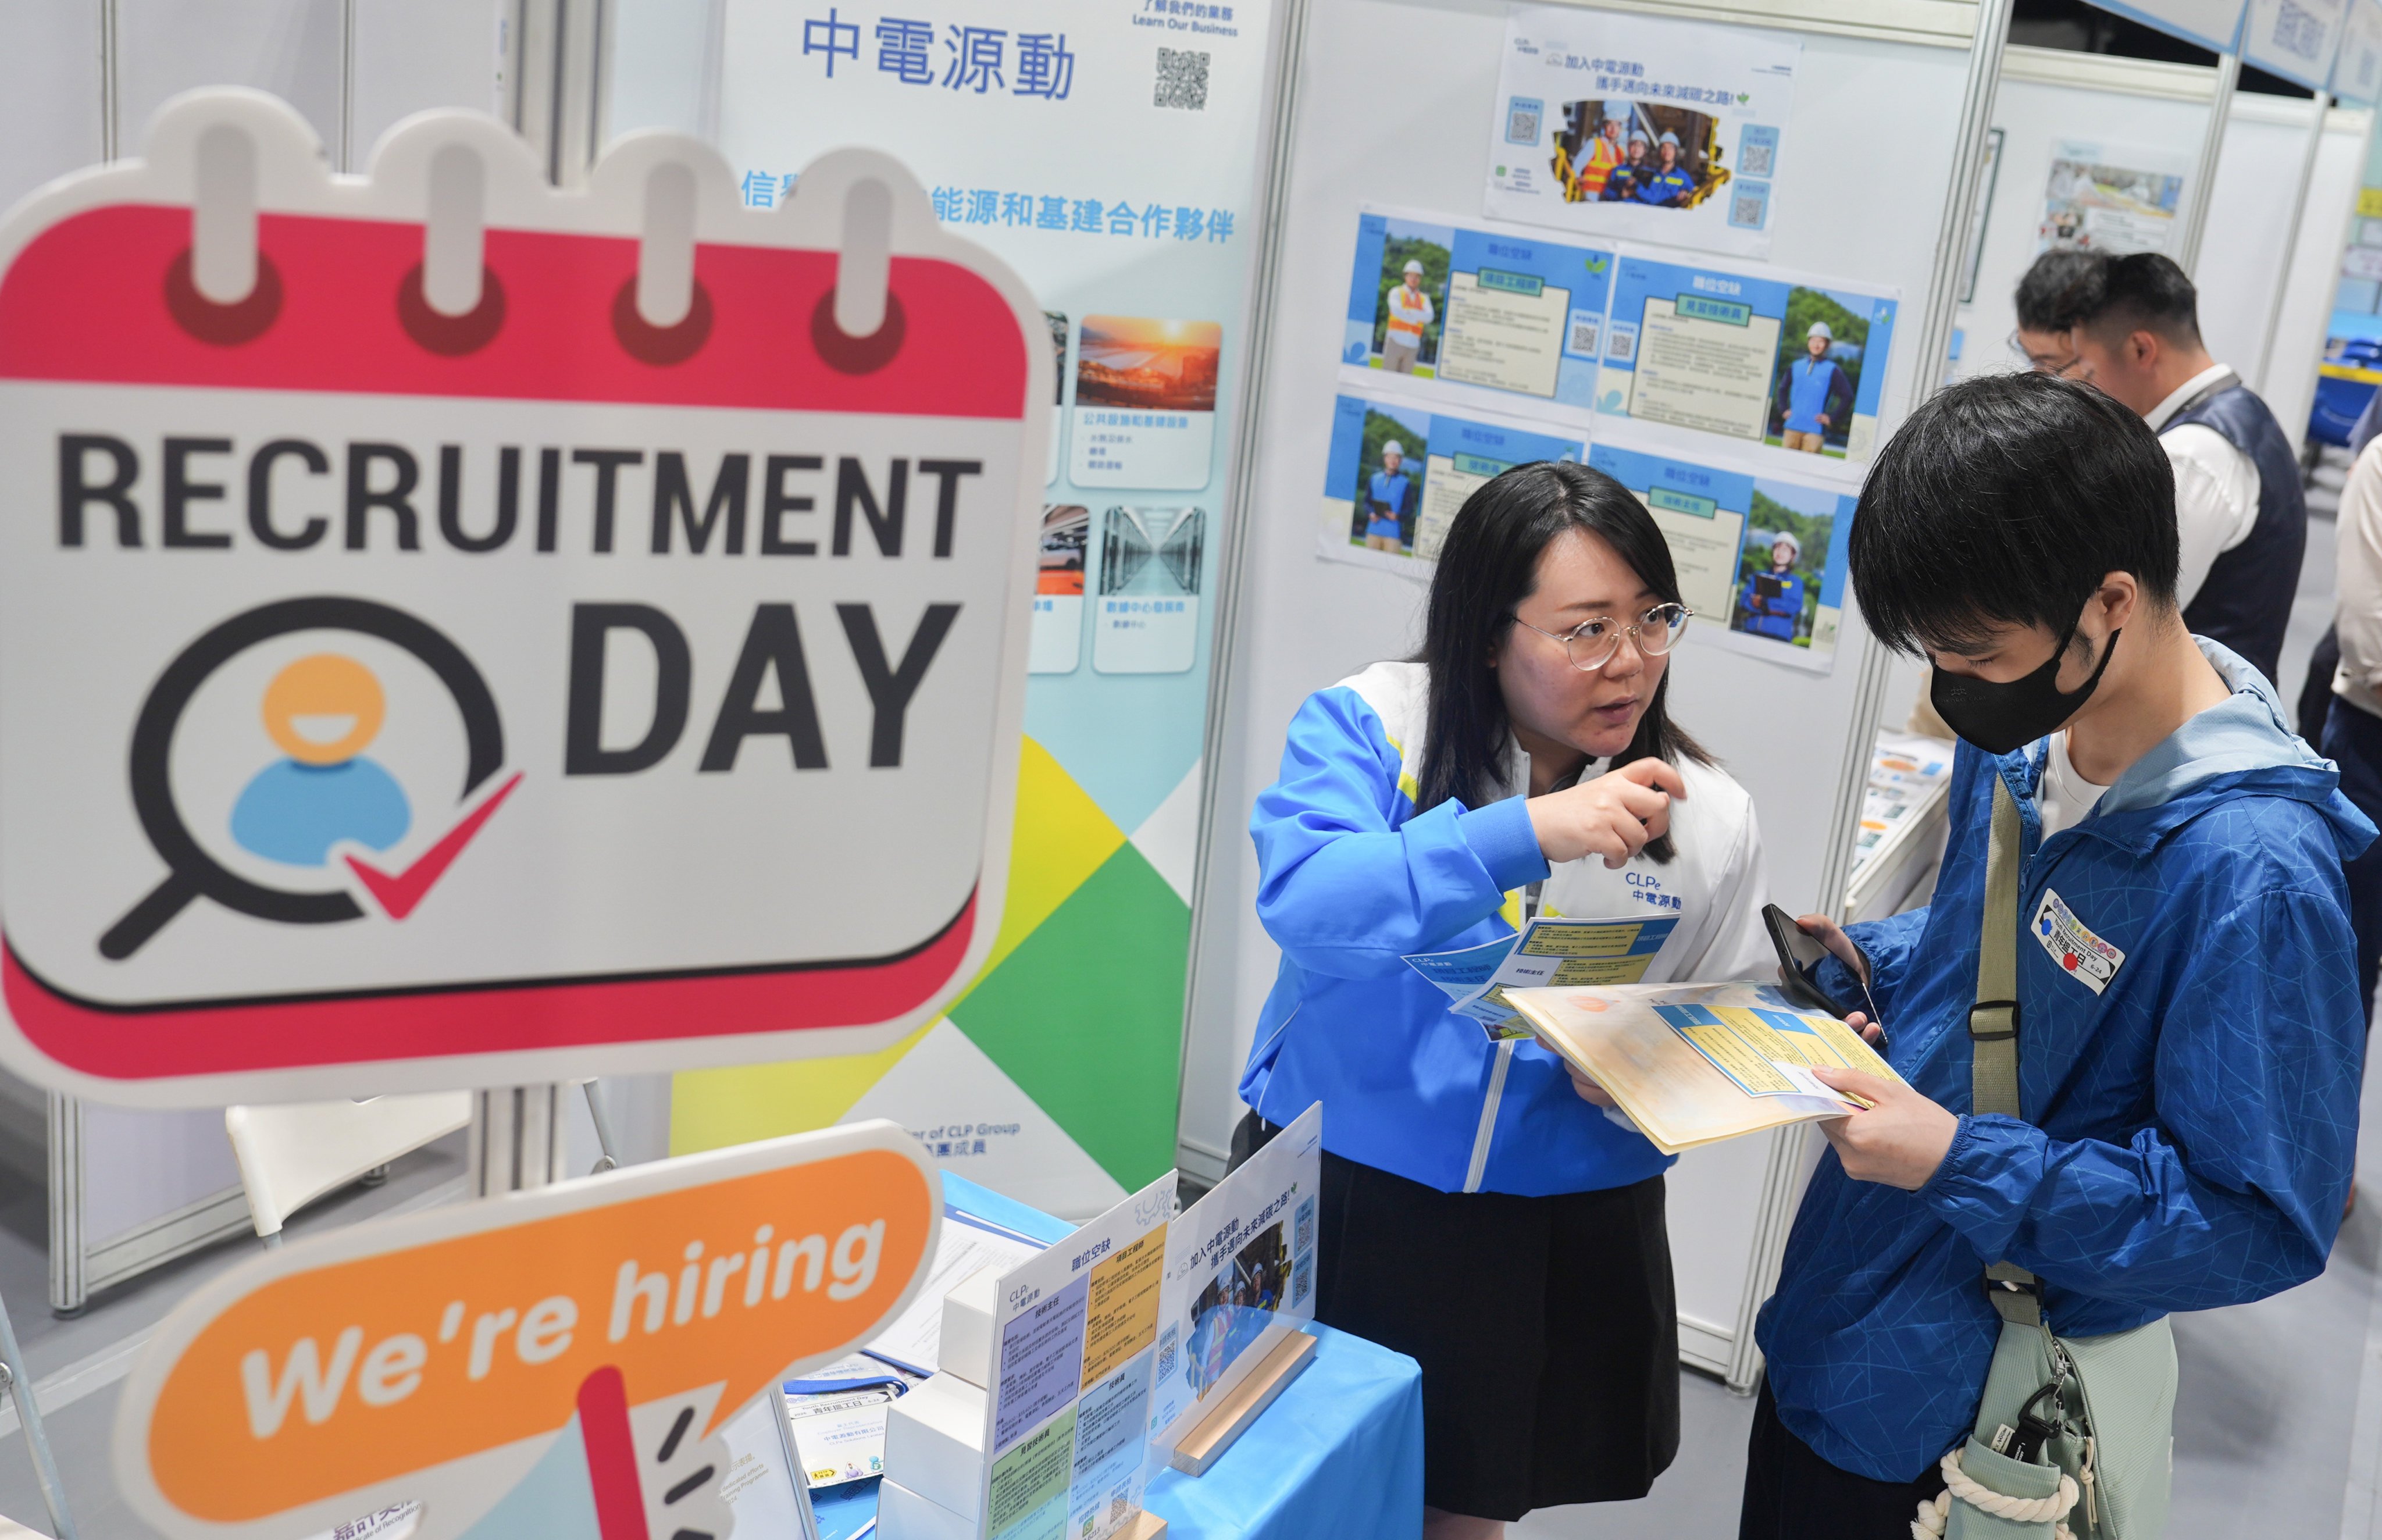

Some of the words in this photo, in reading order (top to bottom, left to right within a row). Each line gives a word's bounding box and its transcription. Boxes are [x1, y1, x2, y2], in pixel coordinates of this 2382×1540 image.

[1132, 13, 1164, 27] Learn
[1168, 18, 1188, 30] Our
[1191, 21, 1238, 37] Business
[803, 7, 1075, 100] 中電源動
[56, 433, 983, 561] RECRUITMENT
[564, 601, 964, 778] DAY
[1632, 889, 1682, 910] 中電源動
[2054, 918, 2063, 931] Youth
[2063, 928, 2086, 953] Recruitment
[2086, 950, 2098, 962] Day
[2090, 964, 2103, 974] 6-24
[930, 1126, 943, 1139] of
[948, 1124, 974, 1138] CLP
[976, 1122, 1021, 1136] Group
[1071, 1237, 1111, 1272] 職位空缺
[1116, 1239, 1145, 1264] 項目工程師
[1190, 1217, 1239, 1270] 加入中電源動
[1012, 1287, 1041, 1313] 中電源動
[1035, 1296, 1060, 1319] 技術主任
[241, 1295, 579, 1440] We're
[606, 1218, 886, 1343] hiring
[1108, 1372, 1125, 1391] 技術員
[812, 1400, 863, 1414] 青年搵工日
[821, 1398, 853, 1407] Recruitment
[823, 1425, 885, 1441] 中電源動有限公司
[1020, 1428, 1050, 1457] 見習技術員
[722, 1473, 747, 1492] dedicated
[747, 1463, 764, 1477] efforts
[741, 1468, 769, 1489] Programme
[383, 1503, 422, 1530] Recognition
